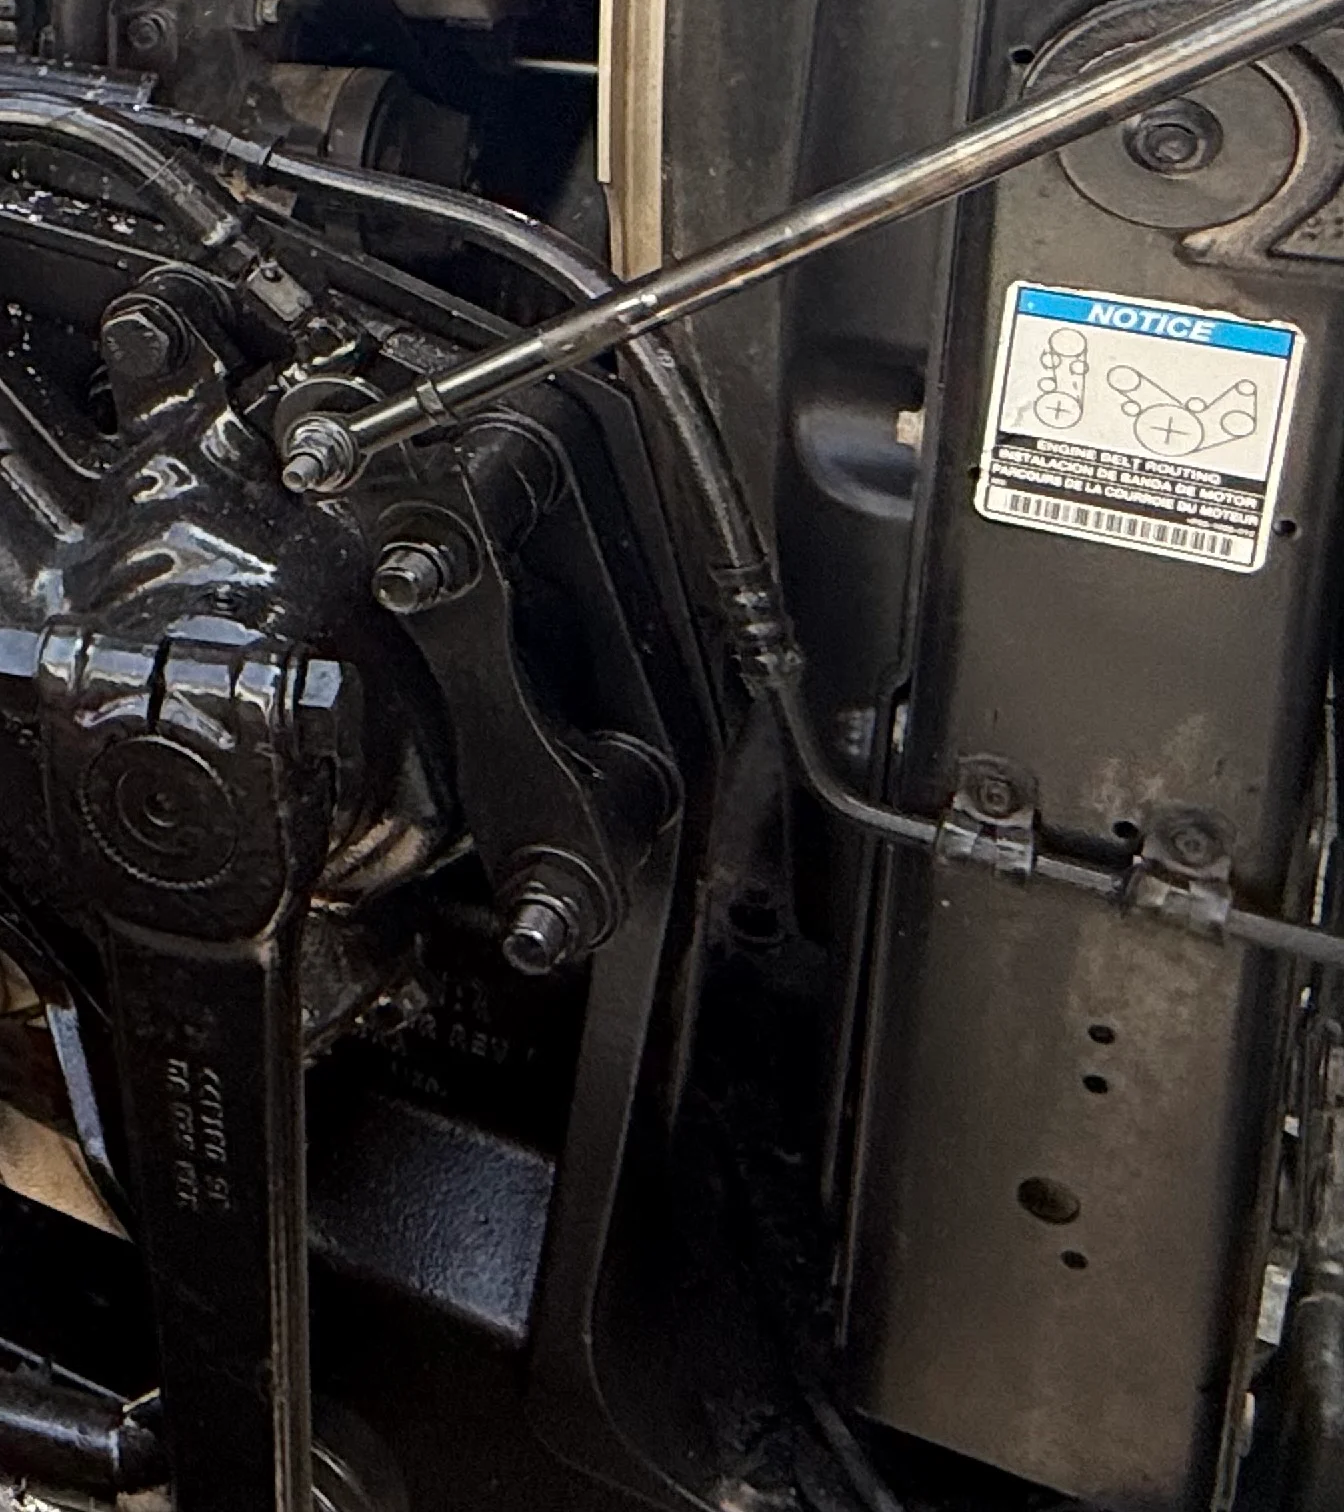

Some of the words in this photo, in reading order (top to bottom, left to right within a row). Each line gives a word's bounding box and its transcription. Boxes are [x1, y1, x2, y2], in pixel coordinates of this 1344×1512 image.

[1088, 303, 1215, 342] NOTICE
[1096, 467, 1118, 482] DE
[1174, 482, 1196, 497] DE
[1198, 487, 1258, 510] MOTOR
[1100, 451, 1143, 471] BELT
[1144, 460, 1222, 486] ROUTING
[1064, 477, 1083, 492] DE
[1085, 481, 1102, 496] LA
[1176, 499, 1198, 515] DU
[1198, 504, 1260, 527] MOTEUR
